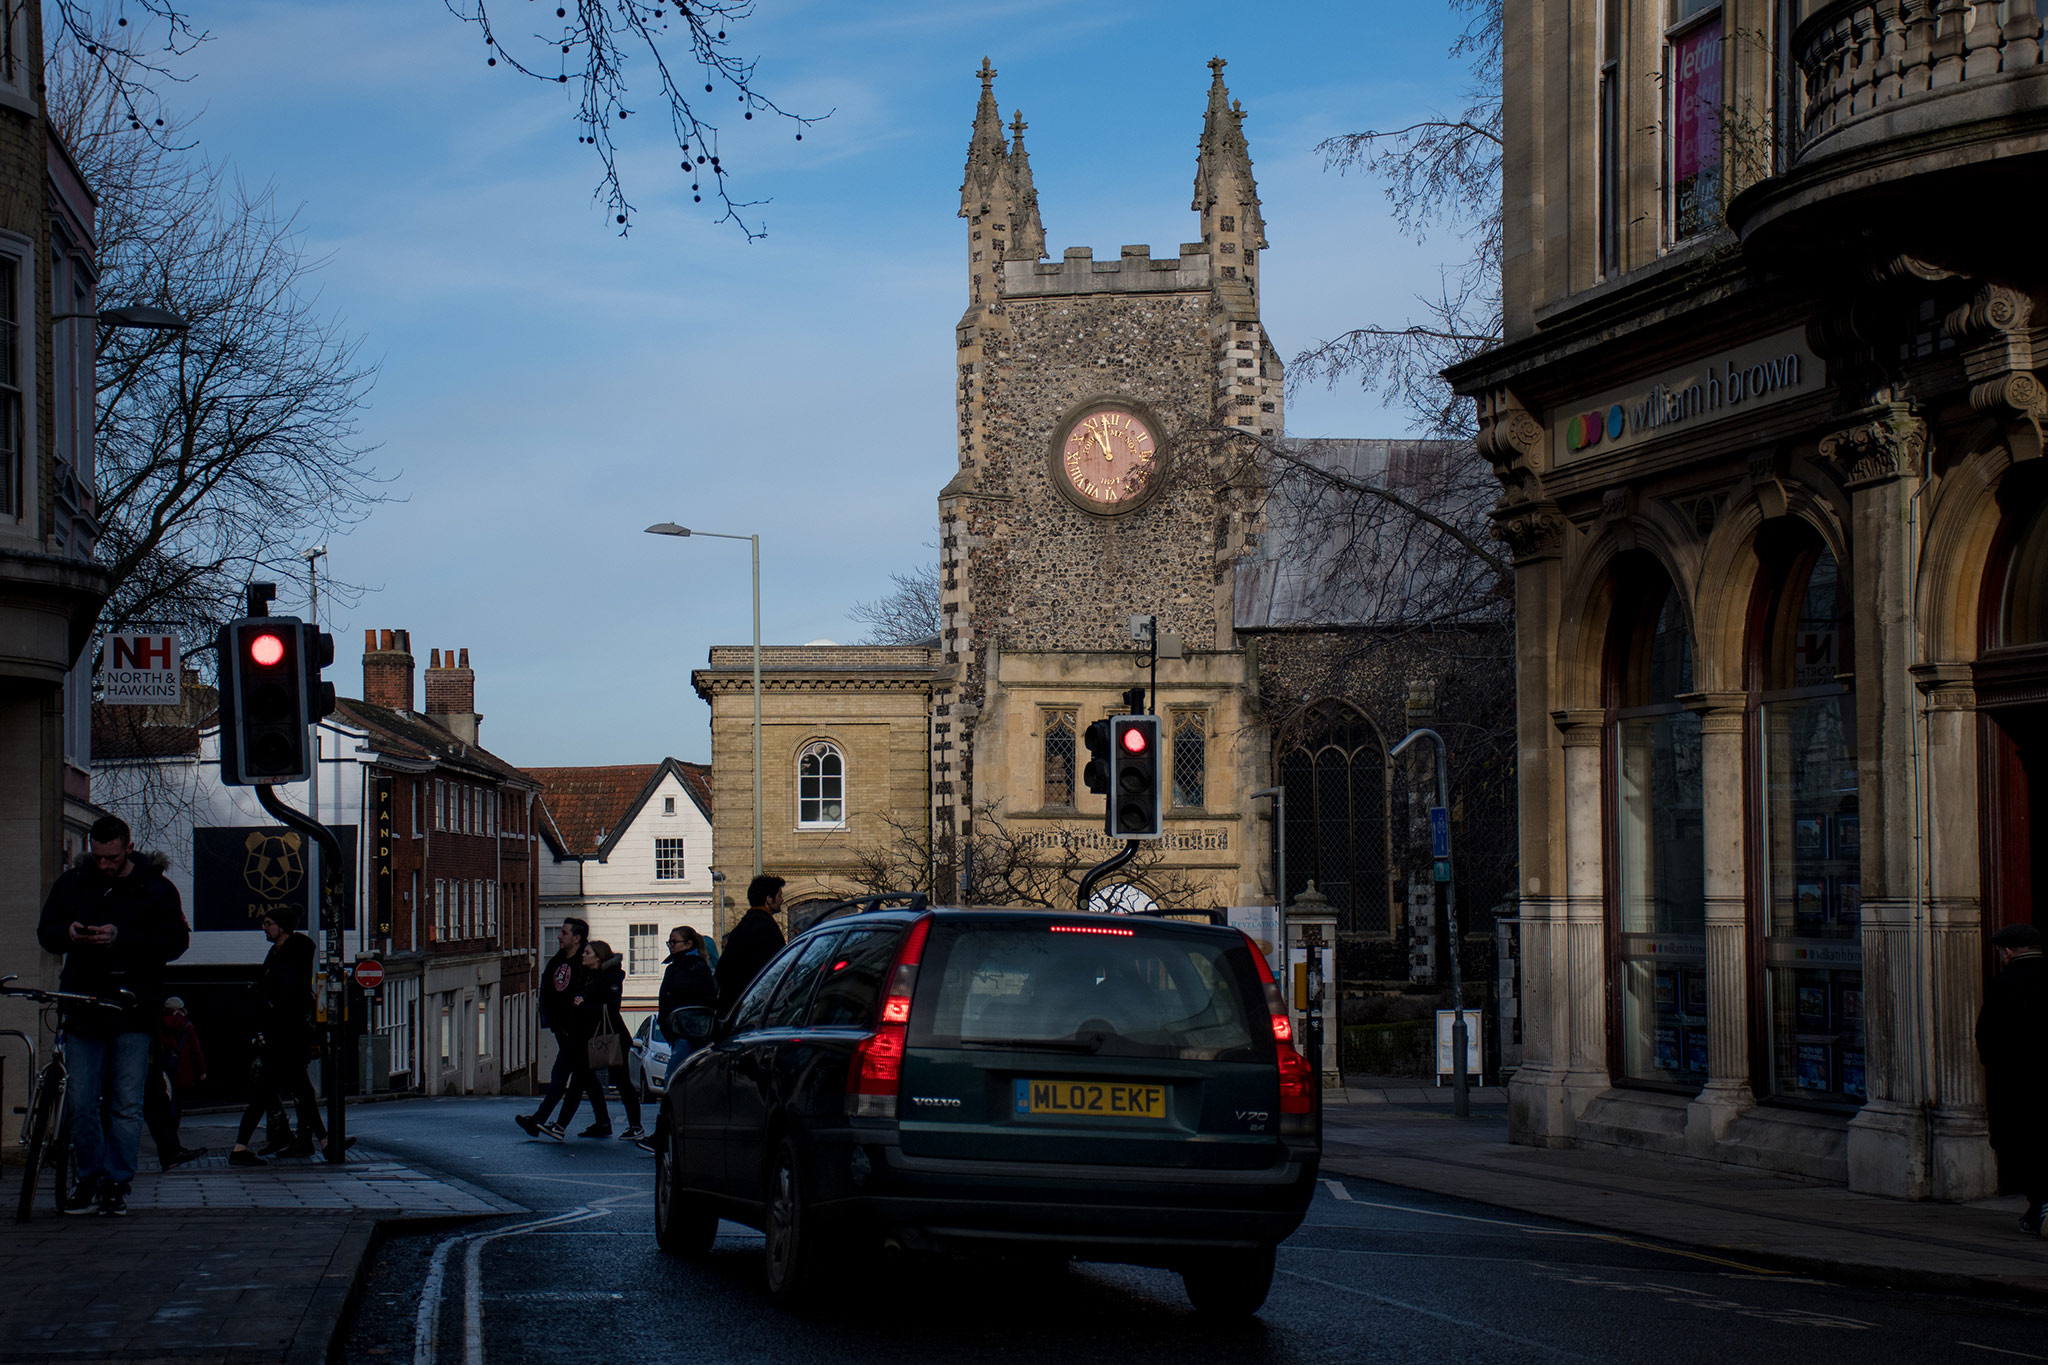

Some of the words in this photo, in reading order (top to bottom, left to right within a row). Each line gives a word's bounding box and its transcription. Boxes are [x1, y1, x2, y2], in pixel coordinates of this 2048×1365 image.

[1680, 31, 1721, 82] lettin
[1629, 383, 1702, 434] william
[1707, 367, 1722, 410] h
[1726, 353, 1800, 405] brown
[114, 637, 171, 669] NH
[108, 672, 162, 683] NORTH
[165, 672, 176, 684] &
[108, 685, 176, 696] HAWKINS
[379, 791, 390, 875] PANDA
[248, 903, 291, 918] PAN
[912, 1097, 961, 1107] VOLVO
[1034, 1084, 1103, 1110] ML02
[1111, 1086, 1161, 1112] EKF
[1235, 1110, 1269, 1121] V70
